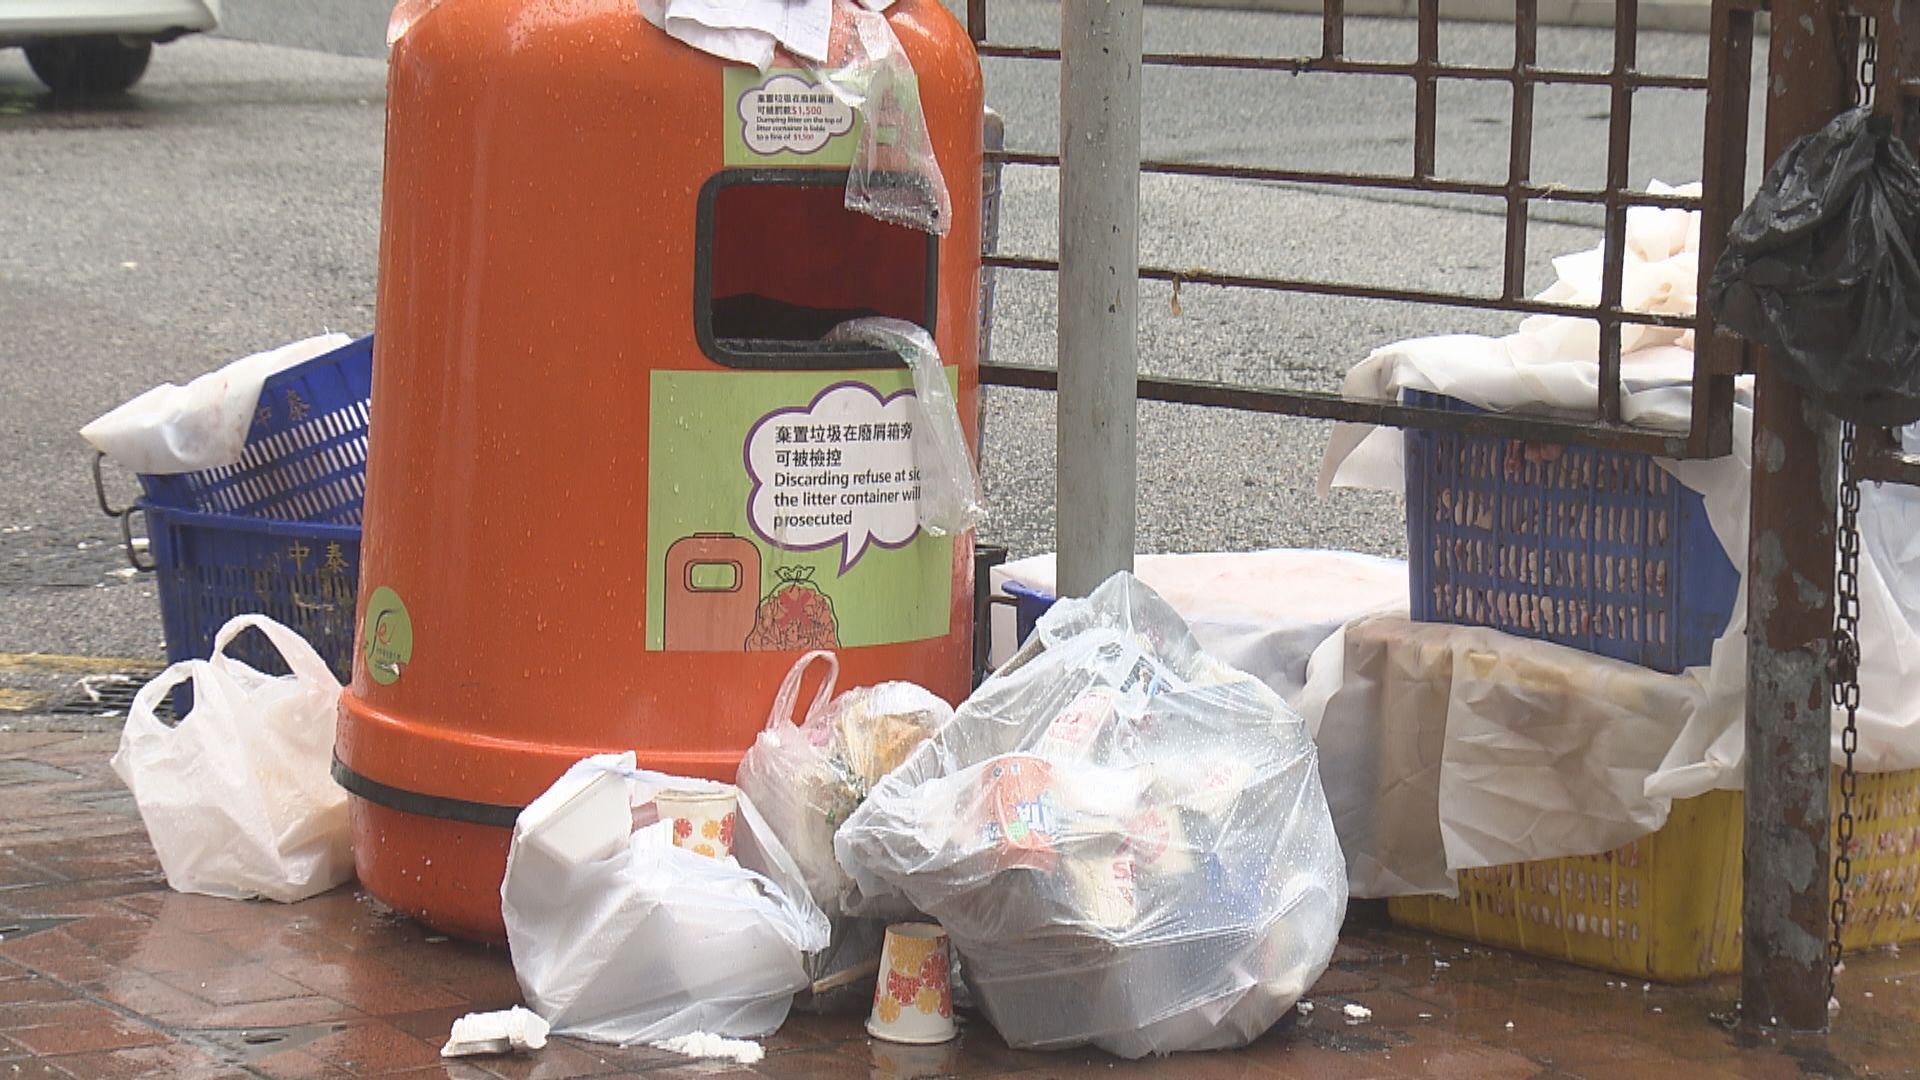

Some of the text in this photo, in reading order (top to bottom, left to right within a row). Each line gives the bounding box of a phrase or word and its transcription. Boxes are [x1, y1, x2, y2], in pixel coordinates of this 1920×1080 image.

[757, 116, 786, 124] Dumping
[824, 116, 836, 124] top
[775, 448, 842, 467] 可被檢控
[774, 470, 849, 489] Discarding
[853, 468, 891, 485] refuse
[894, 468, 906, 483] at
[773, 485, 921, 507] the litter container will
[773, 510, 852, 530] prosecuted
[288, 540, 348, 573] 中泰
